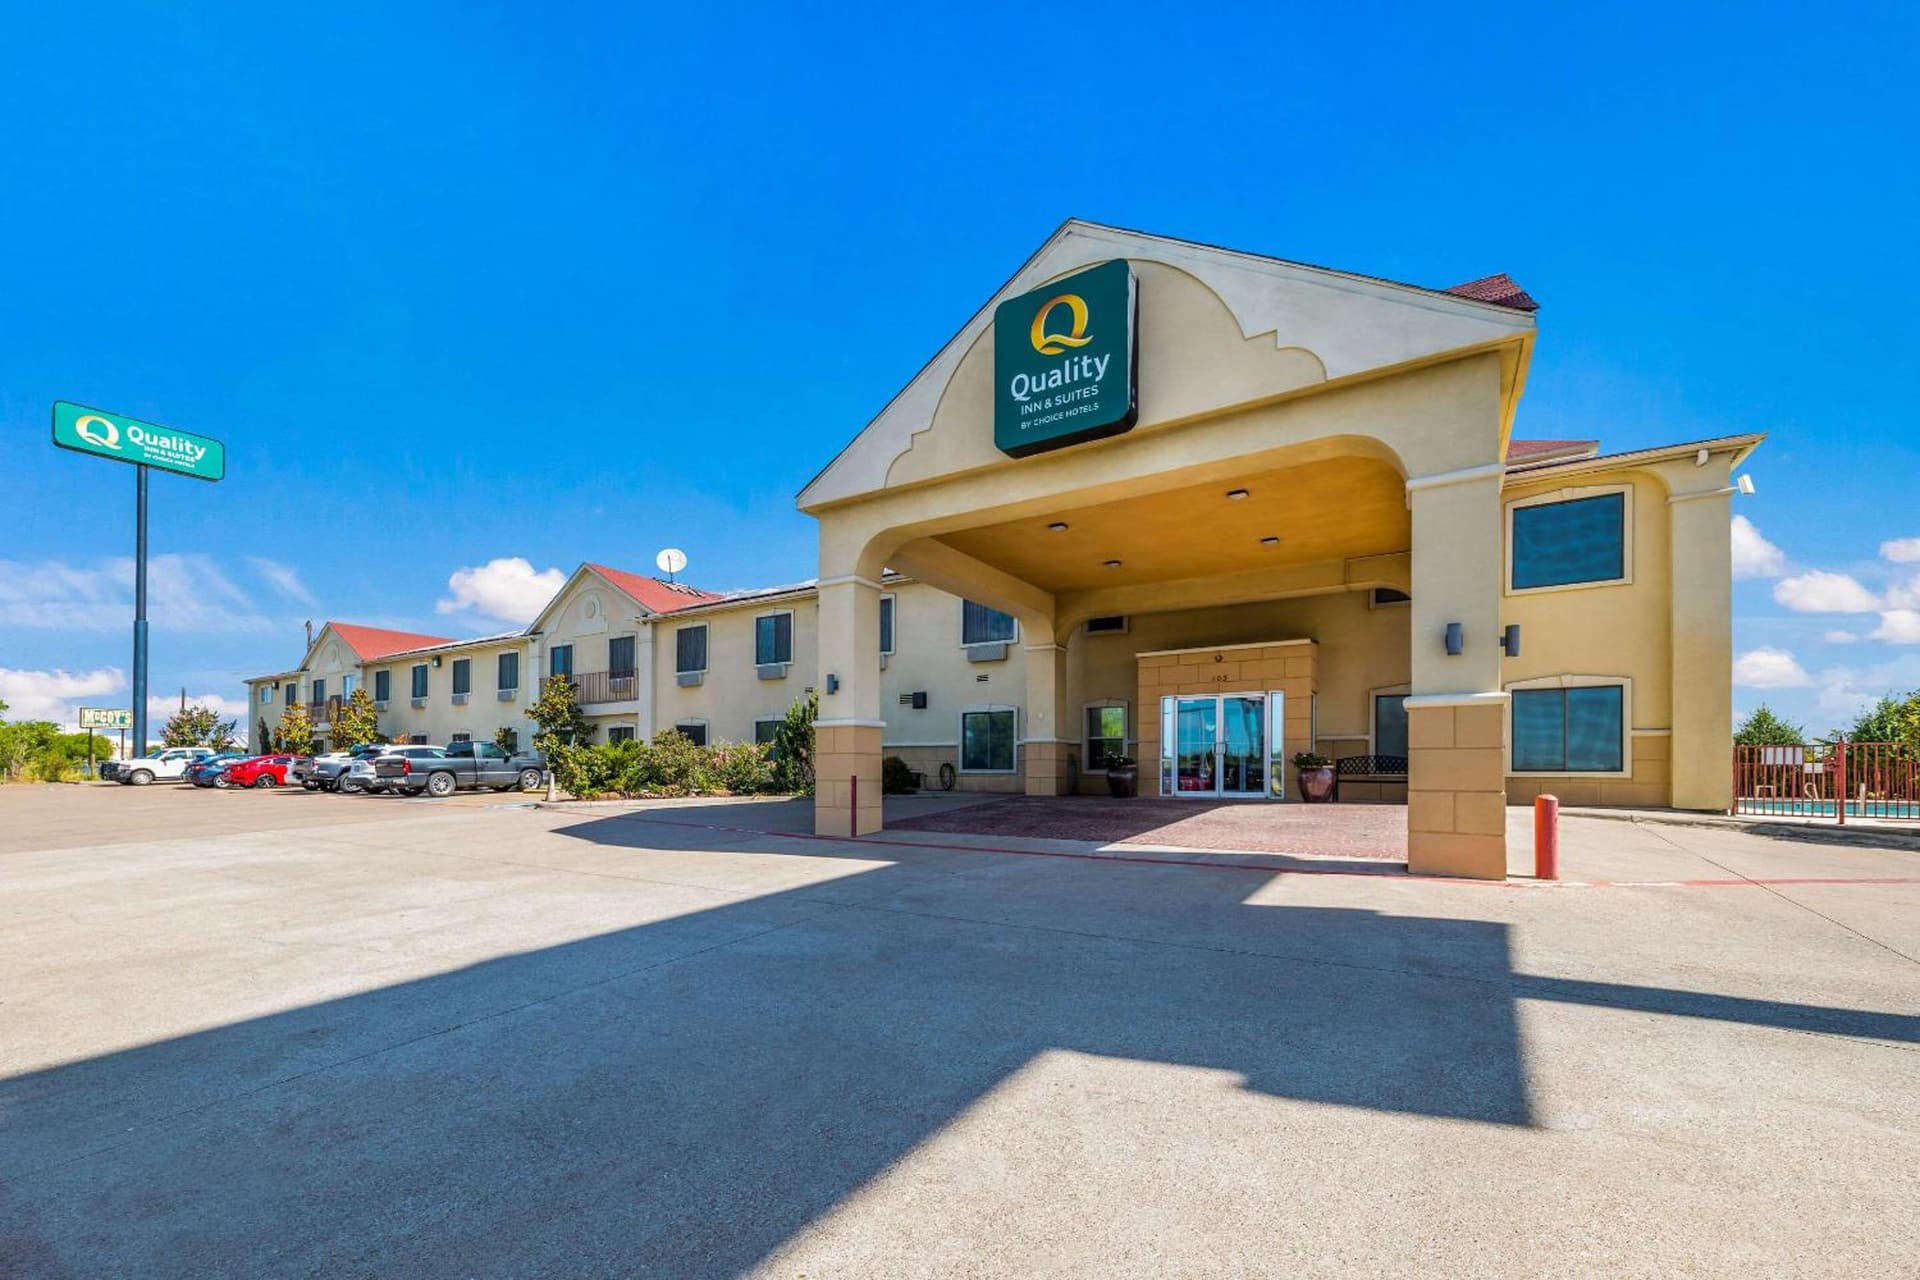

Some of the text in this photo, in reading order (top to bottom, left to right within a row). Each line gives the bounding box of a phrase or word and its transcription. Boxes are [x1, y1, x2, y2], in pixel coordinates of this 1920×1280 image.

[1031, 294, 1094, 355] Q
[1011, 353, 1110, 401] Quality
[1021, 385, 1099, 416] INN & SUITES
[1021, 402, 1099, 430] BY CHOICE HOTELS
[75, 415, 206, 460] Q Quality
